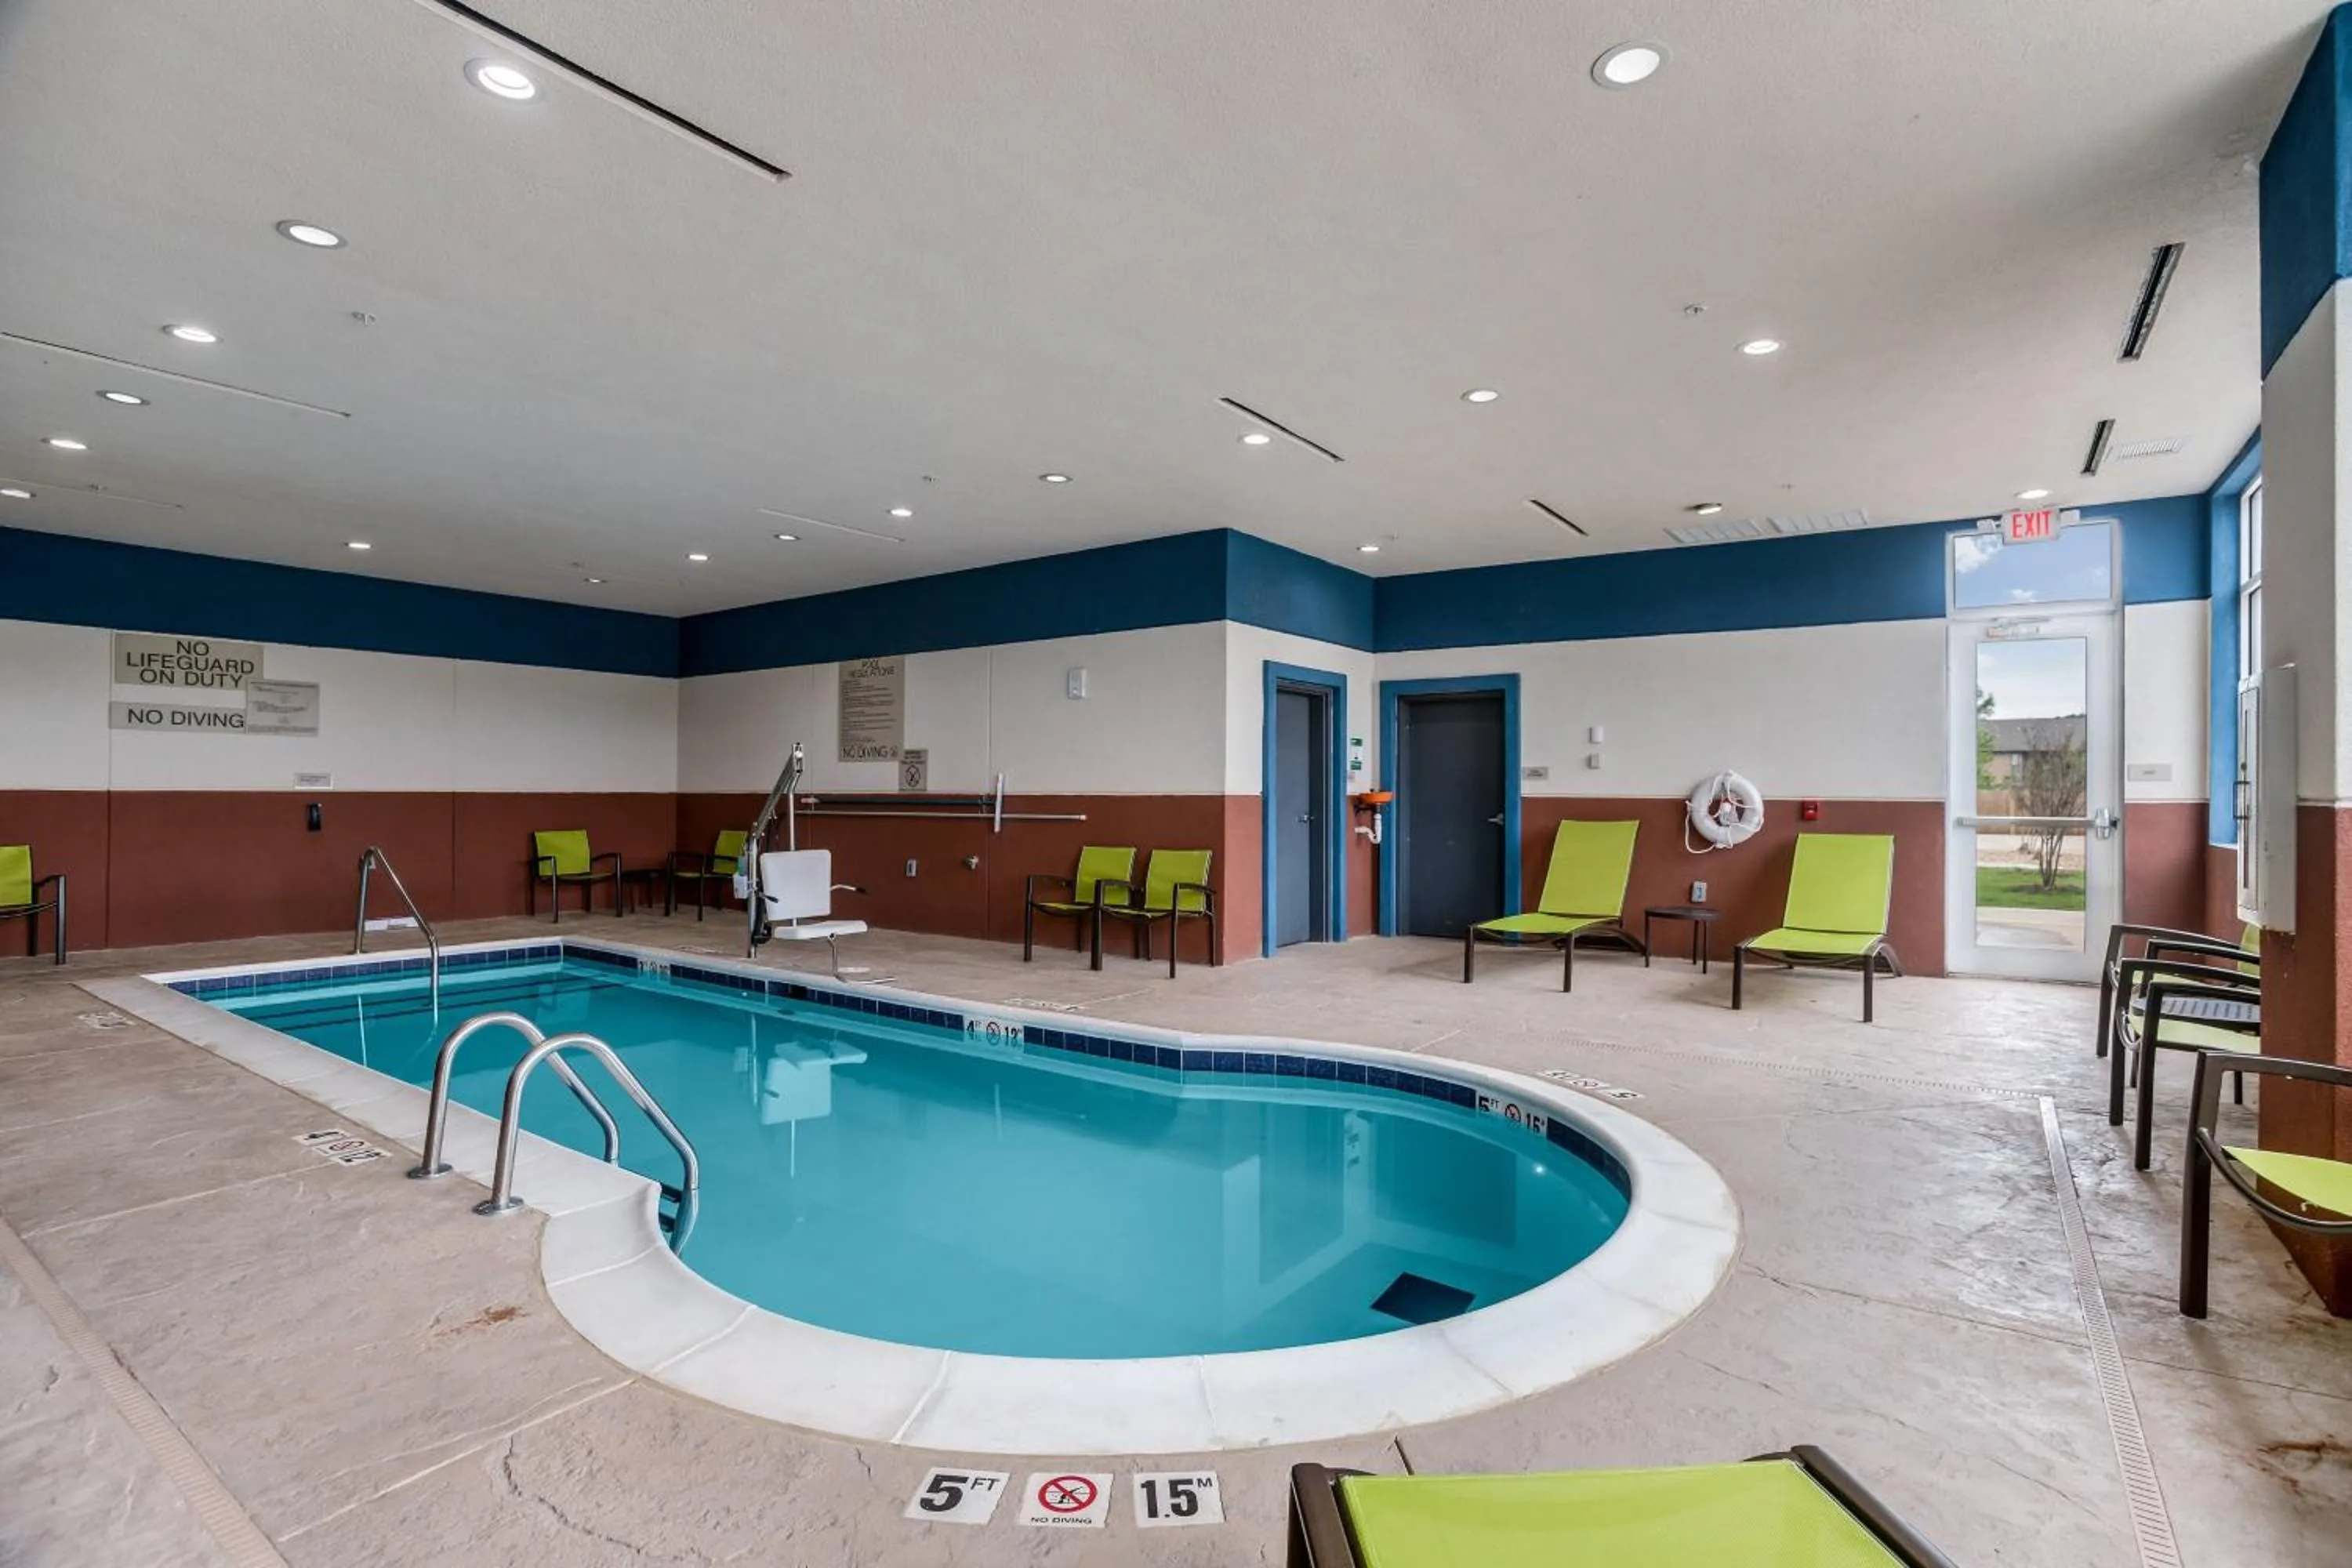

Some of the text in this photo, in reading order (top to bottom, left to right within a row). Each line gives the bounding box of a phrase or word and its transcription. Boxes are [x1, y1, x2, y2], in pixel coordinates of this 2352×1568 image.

[2011, 510, 2052, 539] EXIT
[176, 640, 210, 656] NO
[126, 652, 255, 674] LIFEGUARD
[140, 668, 243, 688] ON DUTY
[128, 708, 245, 728] NO DIVING
